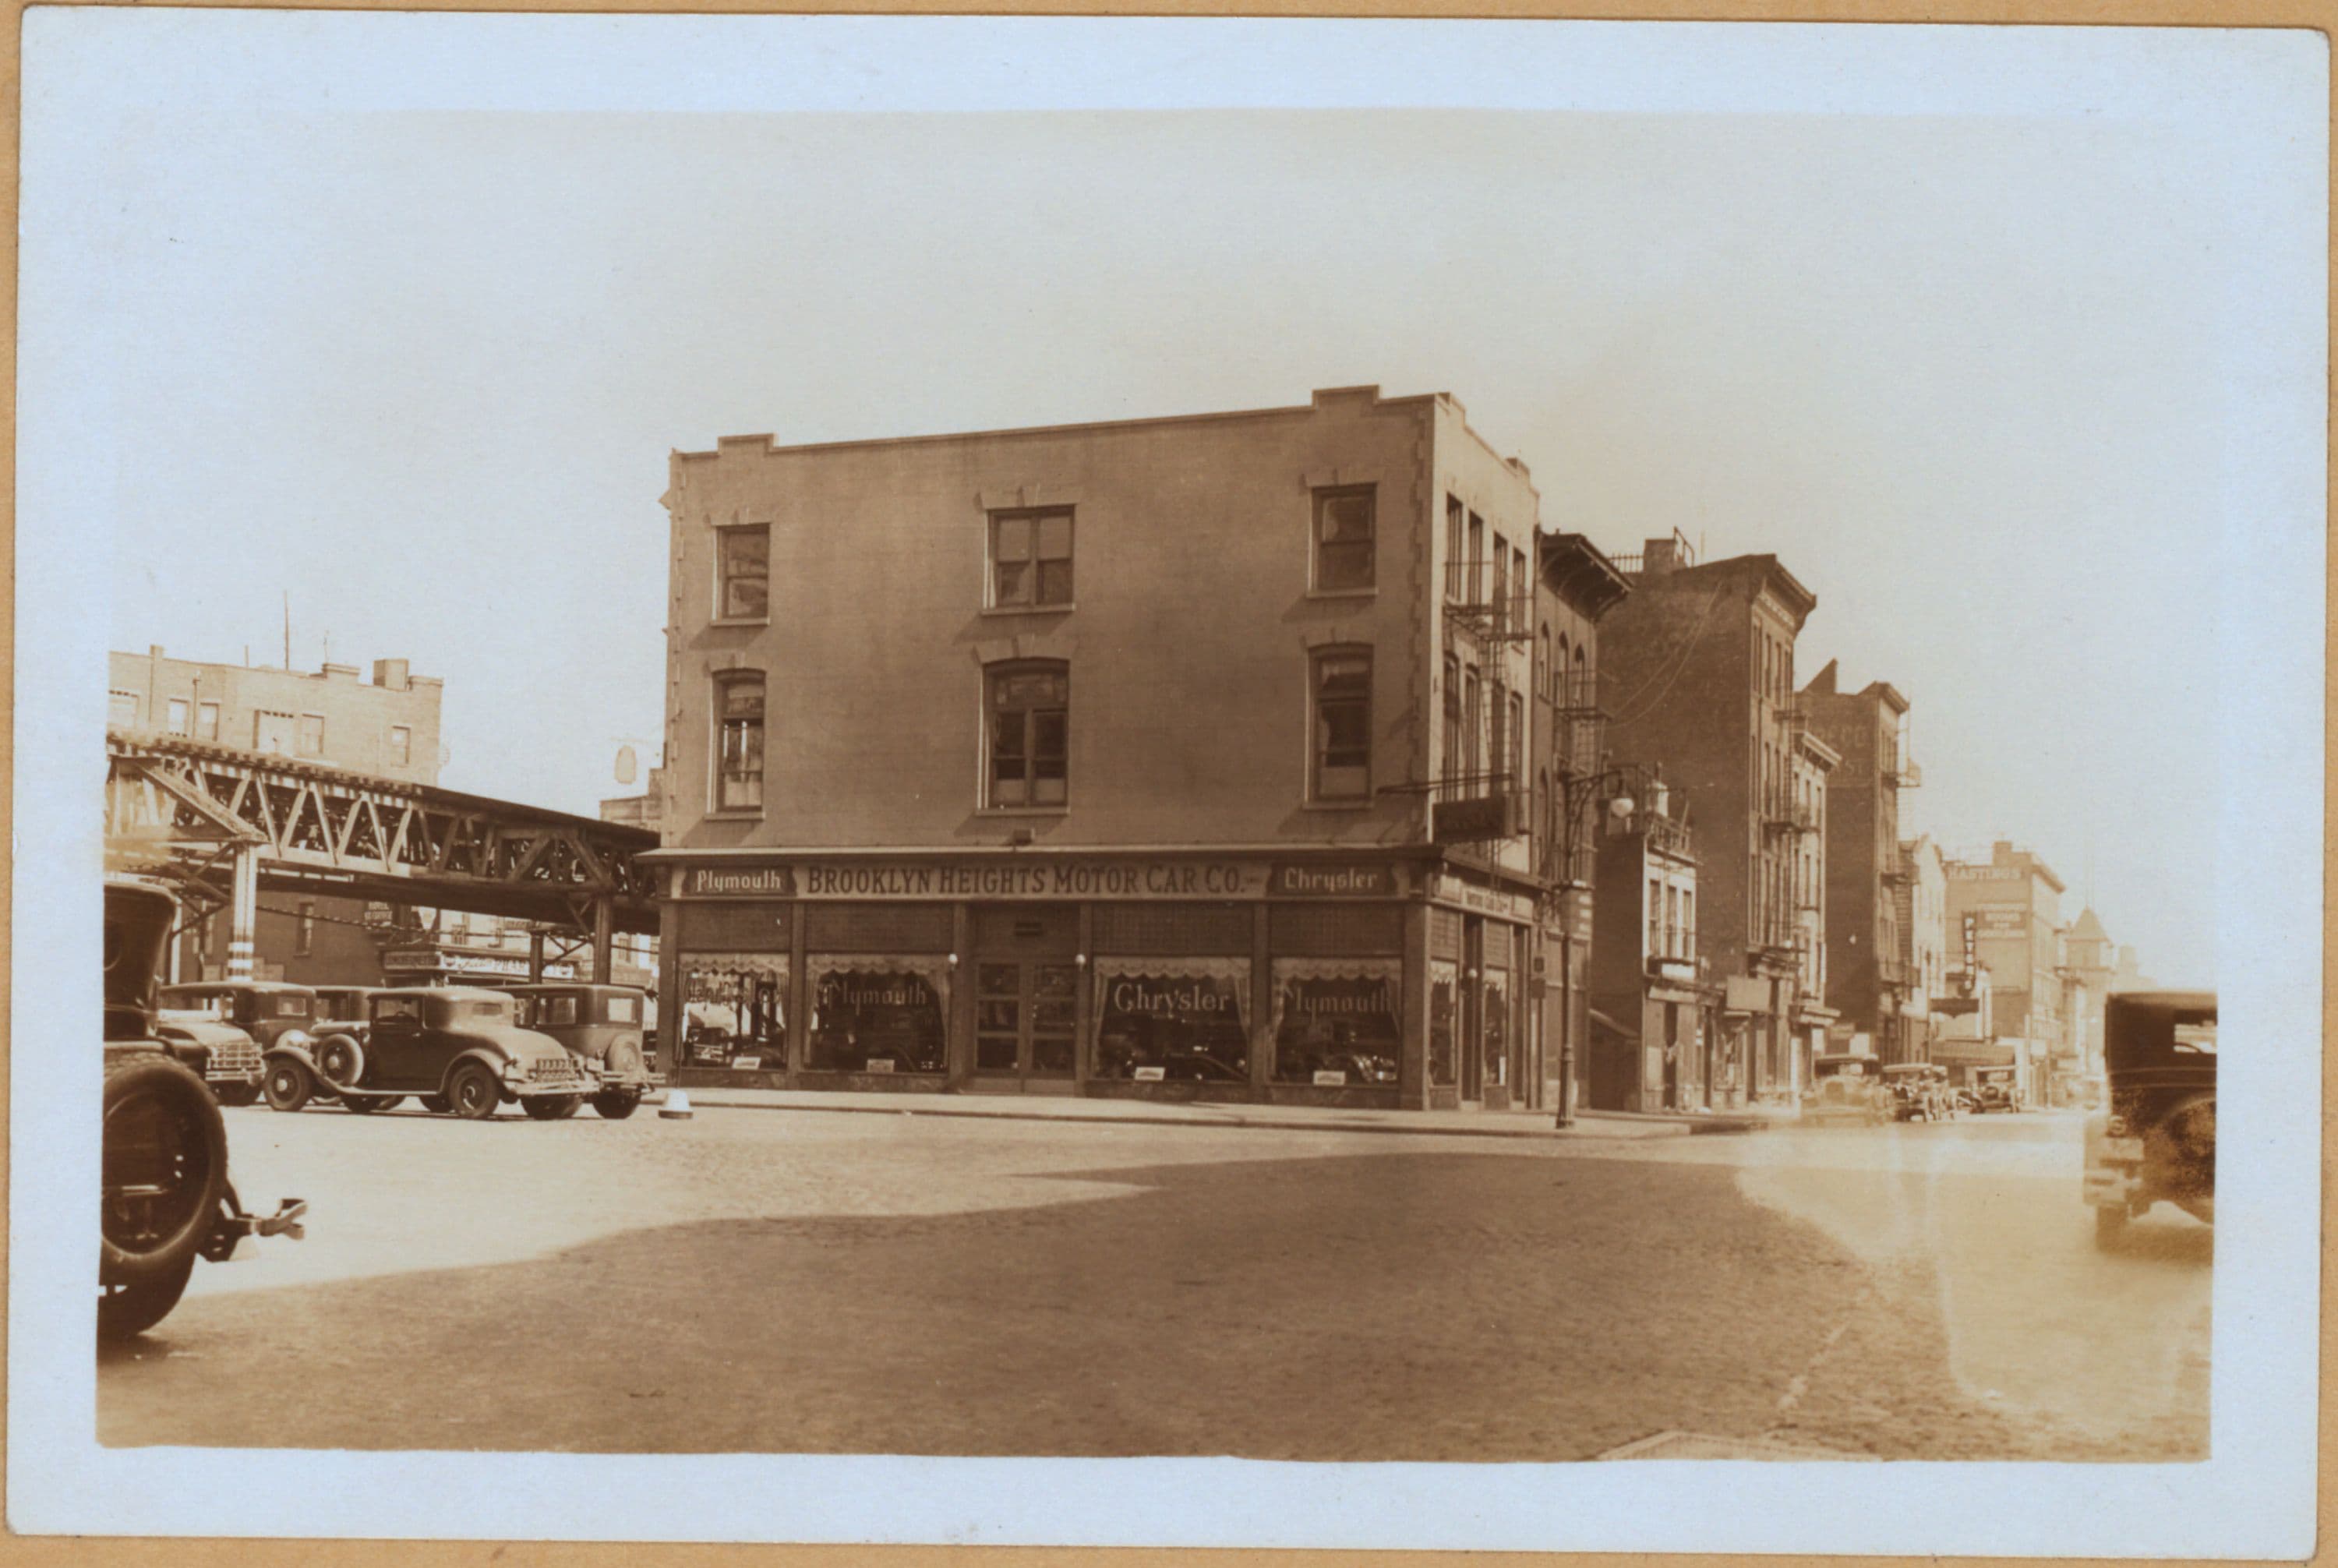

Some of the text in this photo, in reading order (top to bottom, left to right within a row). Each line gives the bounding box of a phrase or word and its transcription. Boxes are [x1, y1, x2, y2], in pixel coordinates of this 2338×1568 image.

[697, 868, 781, 892] Plymouth
[807, 866, 931, 894] BROOKLYN
[938, 866, 1046, 894] HEIGHTS
[1052, 864, 1139, 894] MOTOR
[1146, 865, 1198, 894] CAR
[1284, 866, 1379, 892] Chrysler
[820, 978, 926, 1016] Plymouth
[1114, 981, 1230, 1019] Chrysler
